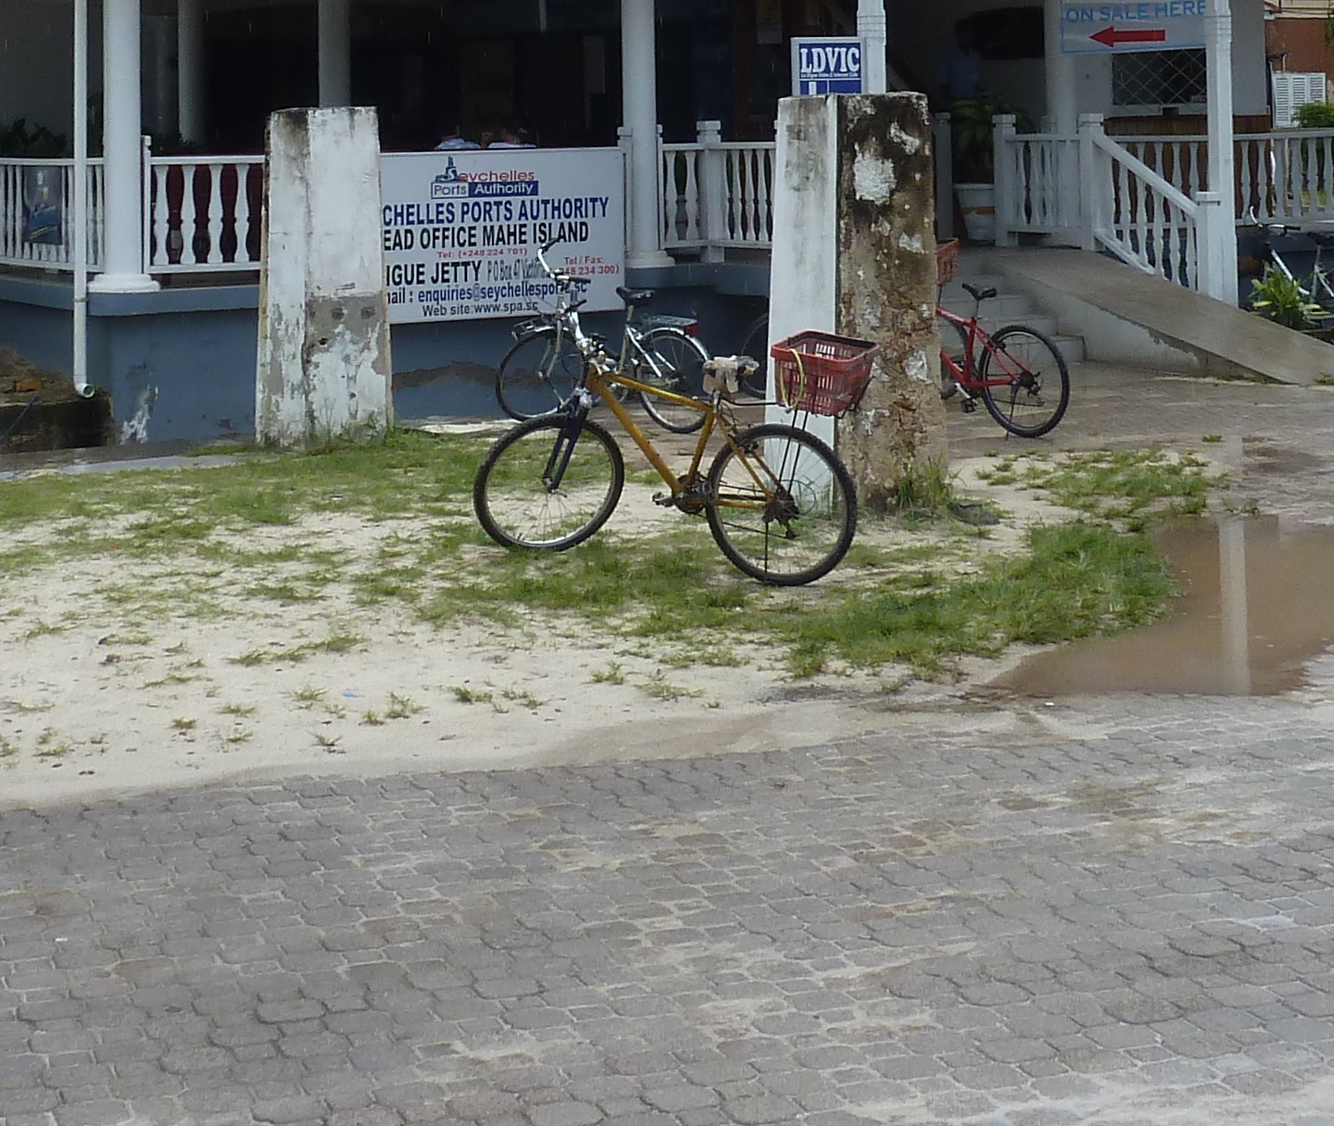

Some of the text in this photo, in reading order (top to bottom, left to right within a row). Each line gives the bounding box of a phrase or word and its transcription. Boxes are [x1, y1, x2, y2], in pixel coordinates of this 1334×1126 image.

[1067, 0, 1206, 23] ON SALE HERE
[800, 47, 860, 73] LDVIC
[448, 168, 535, 183] Seychelles
[434, 182, 533, 196] Ports Authority
[383, 197, 609, 226] CHELLES PORTS AUTHORITY
[384, 221, 589, 251] EAD OFFICE MAHE ISLAND
[387, 260, 482, 286] IGUE JETTY
[578, 266, 595, 275] 234
[387, 286, 405, 305] ail
[423, 304, 446, 317] Web
